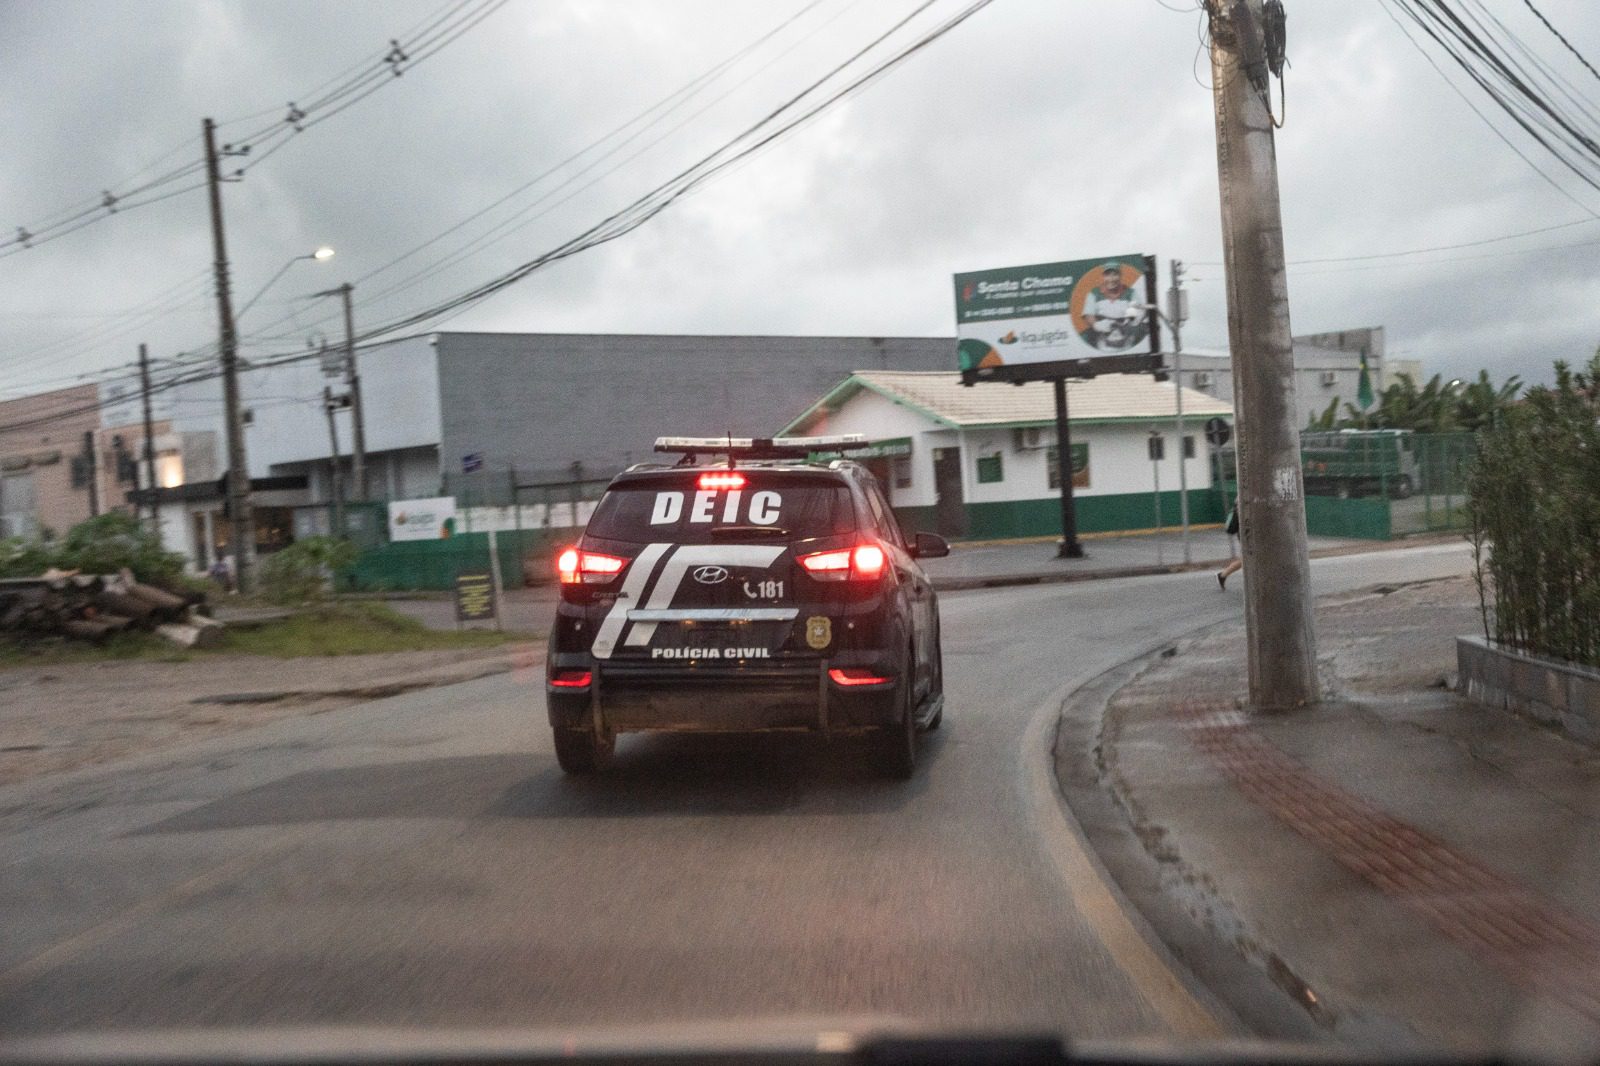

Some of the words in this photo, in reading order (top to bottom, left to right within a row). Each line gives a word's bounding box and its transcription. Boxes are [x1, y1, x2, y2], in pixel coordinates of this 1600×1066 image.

[977, 280, 1019, 294] Santa
[650, 491, 782, 525] DEIC
[758, 580, 784, 599] 181
[652, 645, 721, 659] POLÍCIA
[724, 647, 770, 659] CIVIL
